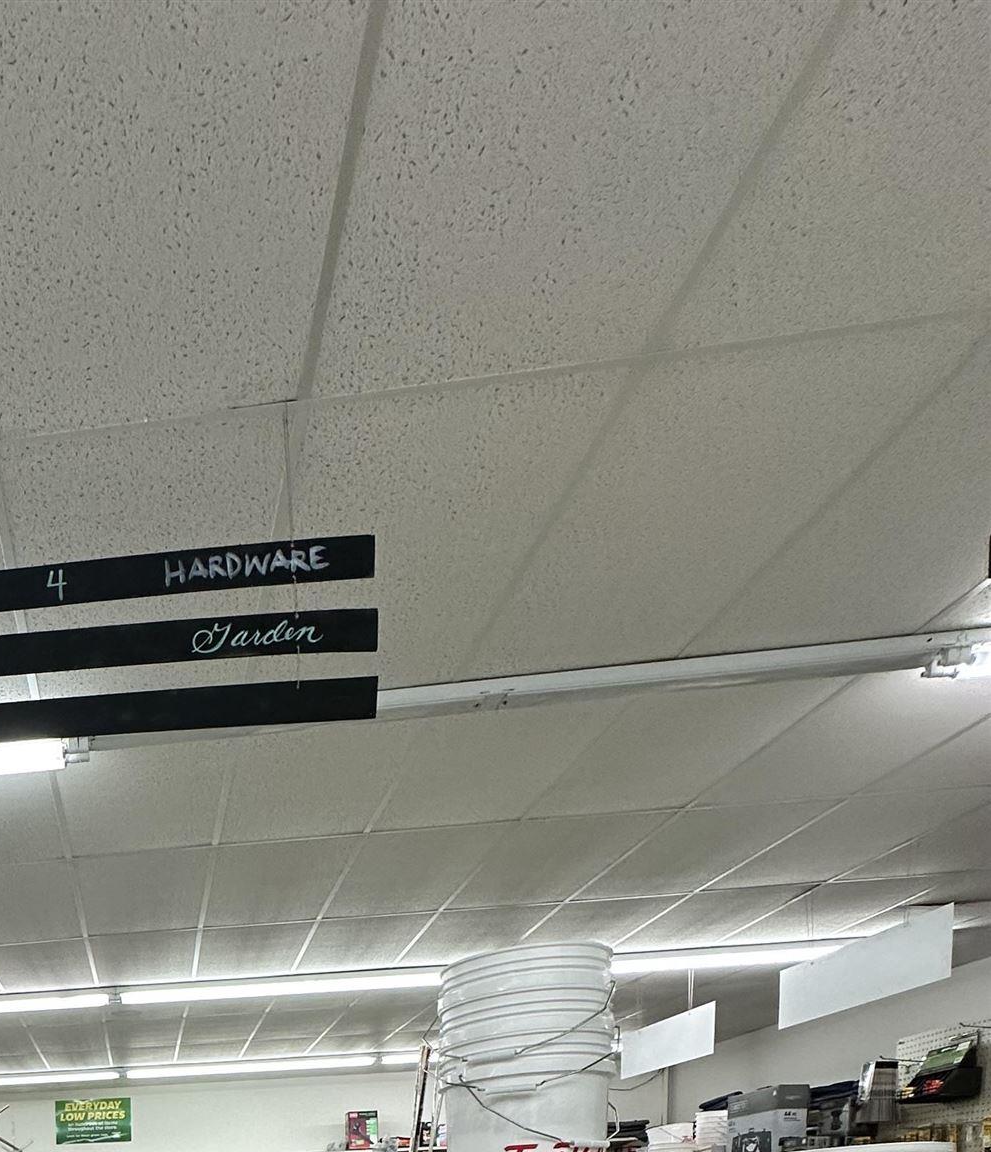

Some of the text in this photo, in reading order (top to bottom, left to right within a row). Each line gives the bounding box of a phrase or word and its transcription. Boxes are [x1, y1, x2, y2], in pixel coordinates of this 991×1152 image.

[46, 569, 67, 601] 4
[164, 545, 330, 587] HARDWARE
[192, 620, 323, 654] Garden
[60, 1111, 126, 1122] LOW PRICES
[65, 1101, 122, 1112] EVERYDAY
